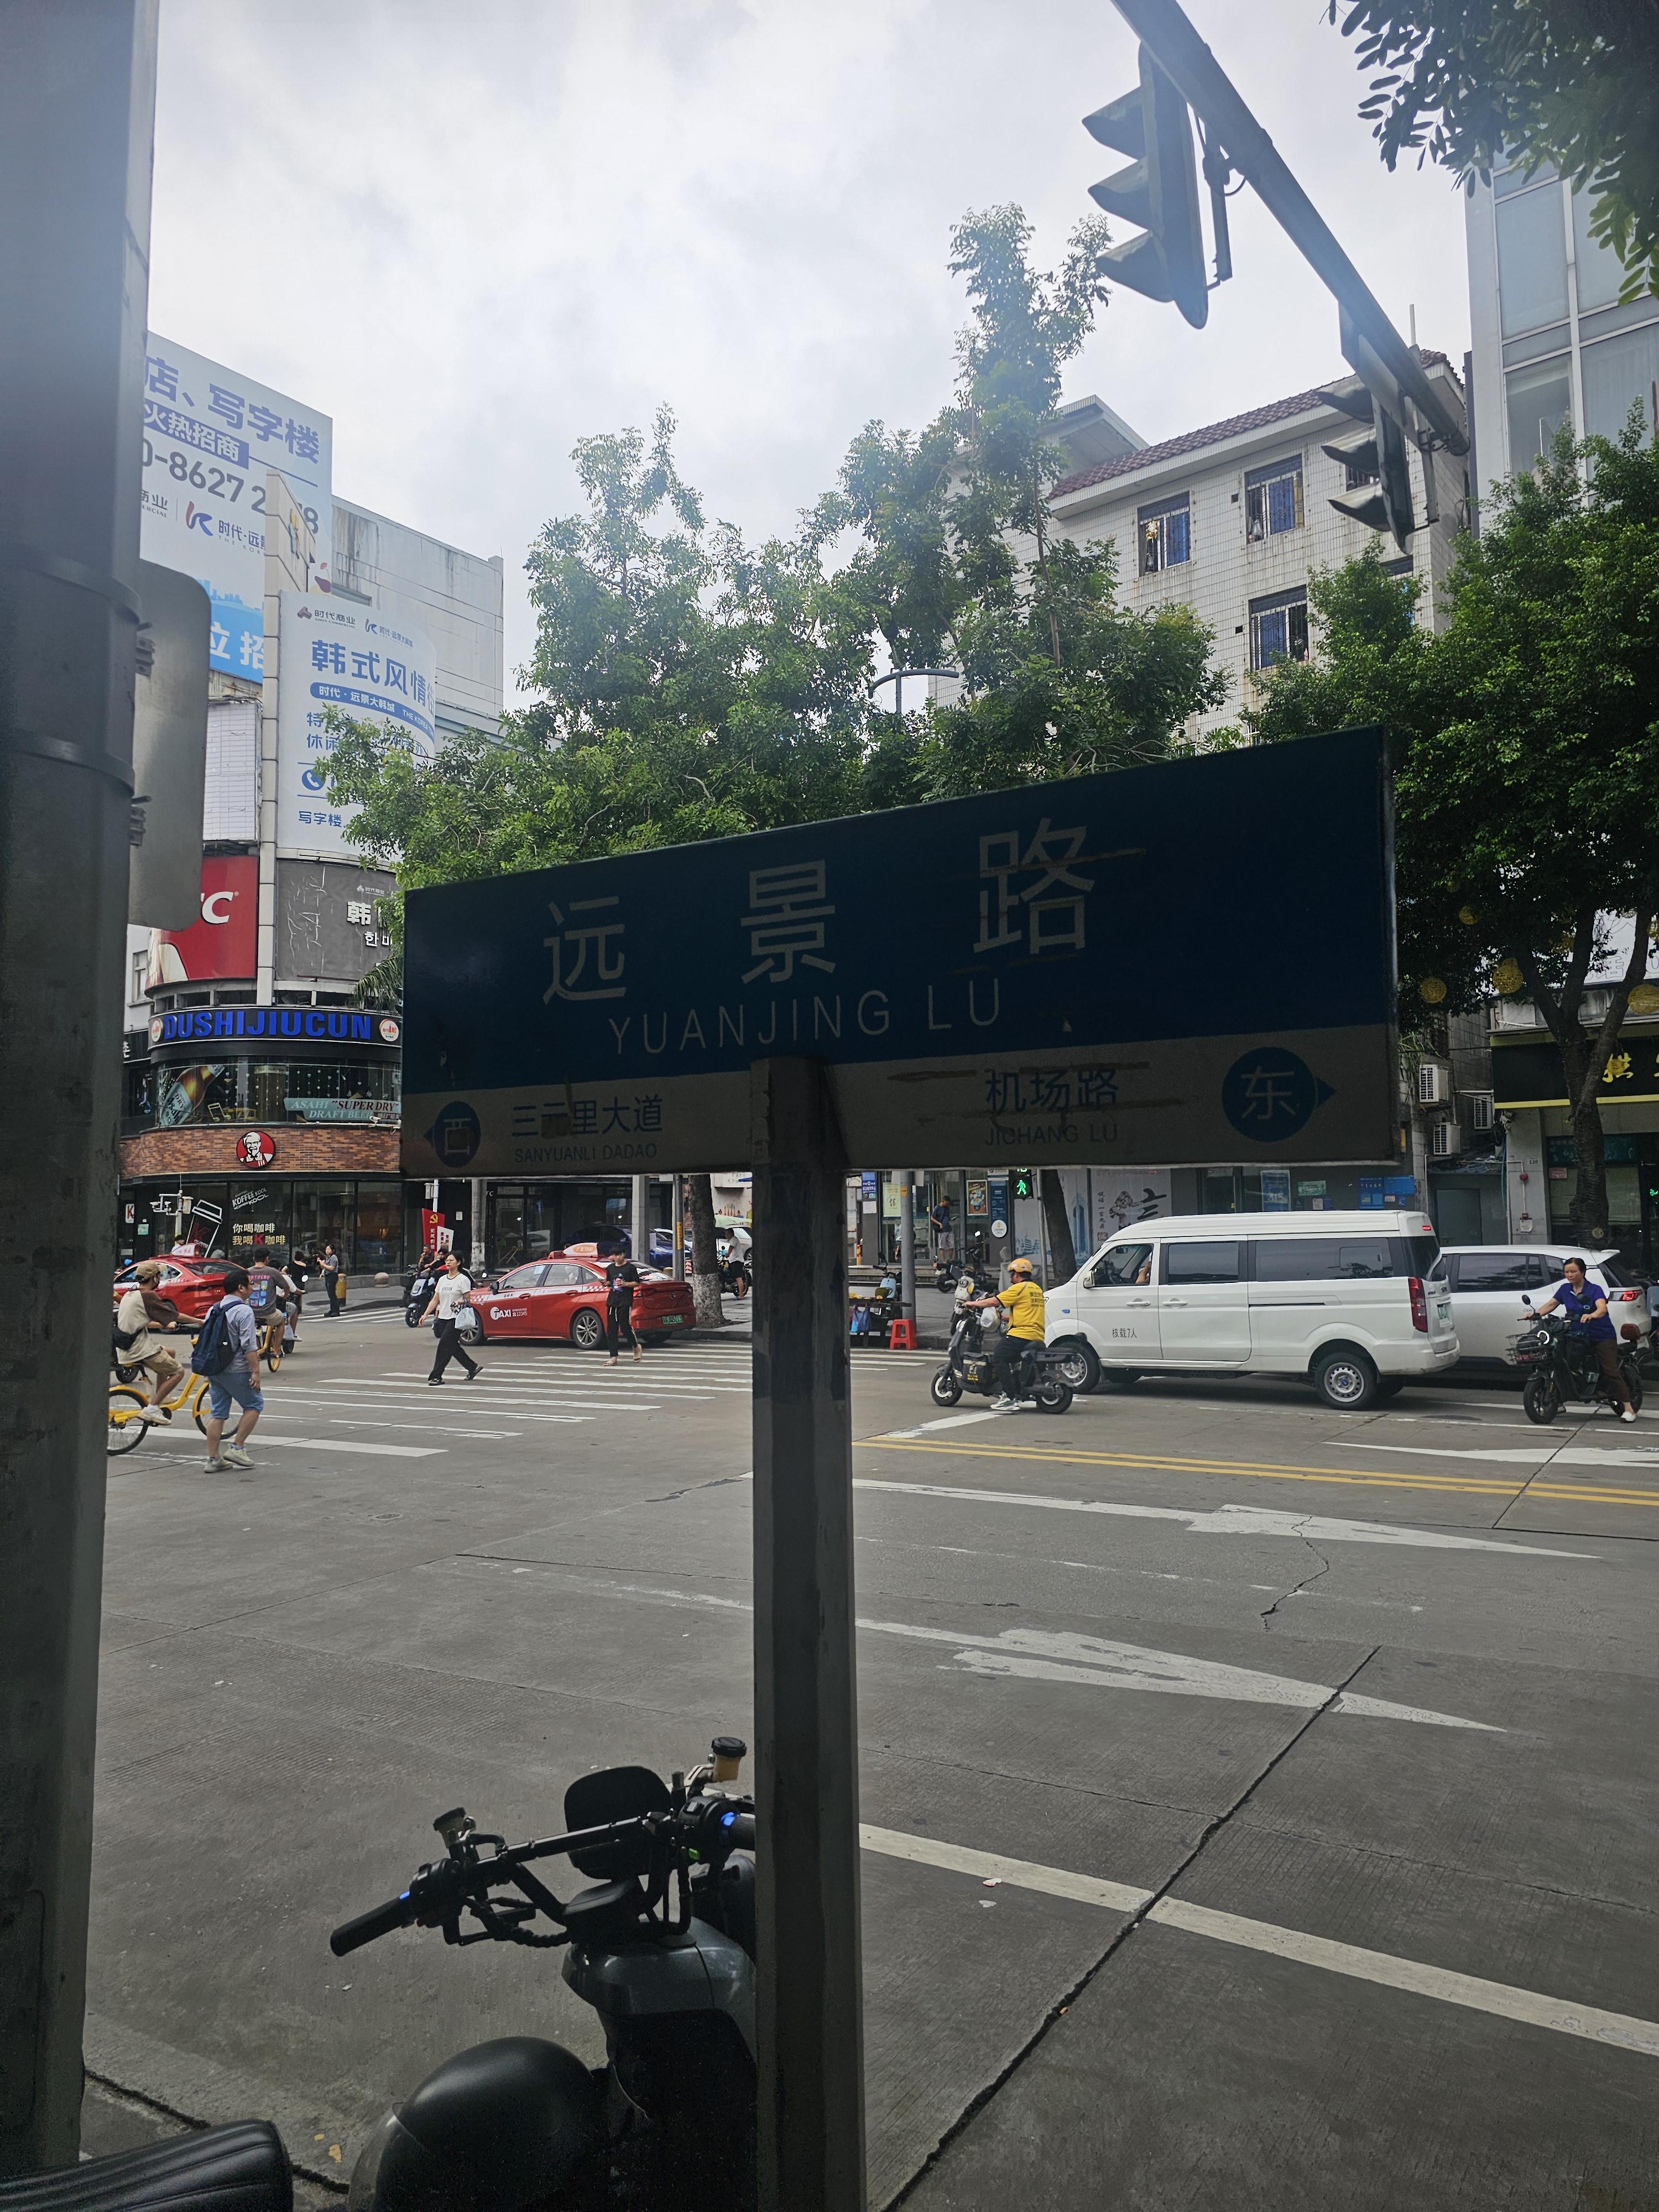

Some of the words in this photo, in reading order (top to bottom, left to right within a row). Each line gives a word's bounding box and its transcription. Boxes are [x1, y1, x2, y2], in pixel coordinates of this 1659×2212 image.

[315, 610, 355, 625] 时代商业
[542, 816, 1095, 1005] 远景路
[164, 1010, 371, 1040] DUSHIJIUCUN
[608, 989, 891, 1056] YUANJING
[927, 977, 1000, 1030] LU
[985, 1067, 1119, 1115] 机场路
[1241, 1065, 1298, 1121] 东
[291, 1100, 328, 1109] ASAHI
[309, 1110, 344, 1119] DRAFT
[1089, 1123, 1118, 1142] LU
[514, 1146, 596, 1164] SANYUANLI
[602, 1143, 658, 1161] DADAO
[232, 1223, 275, 1233] 你喝咖啡
